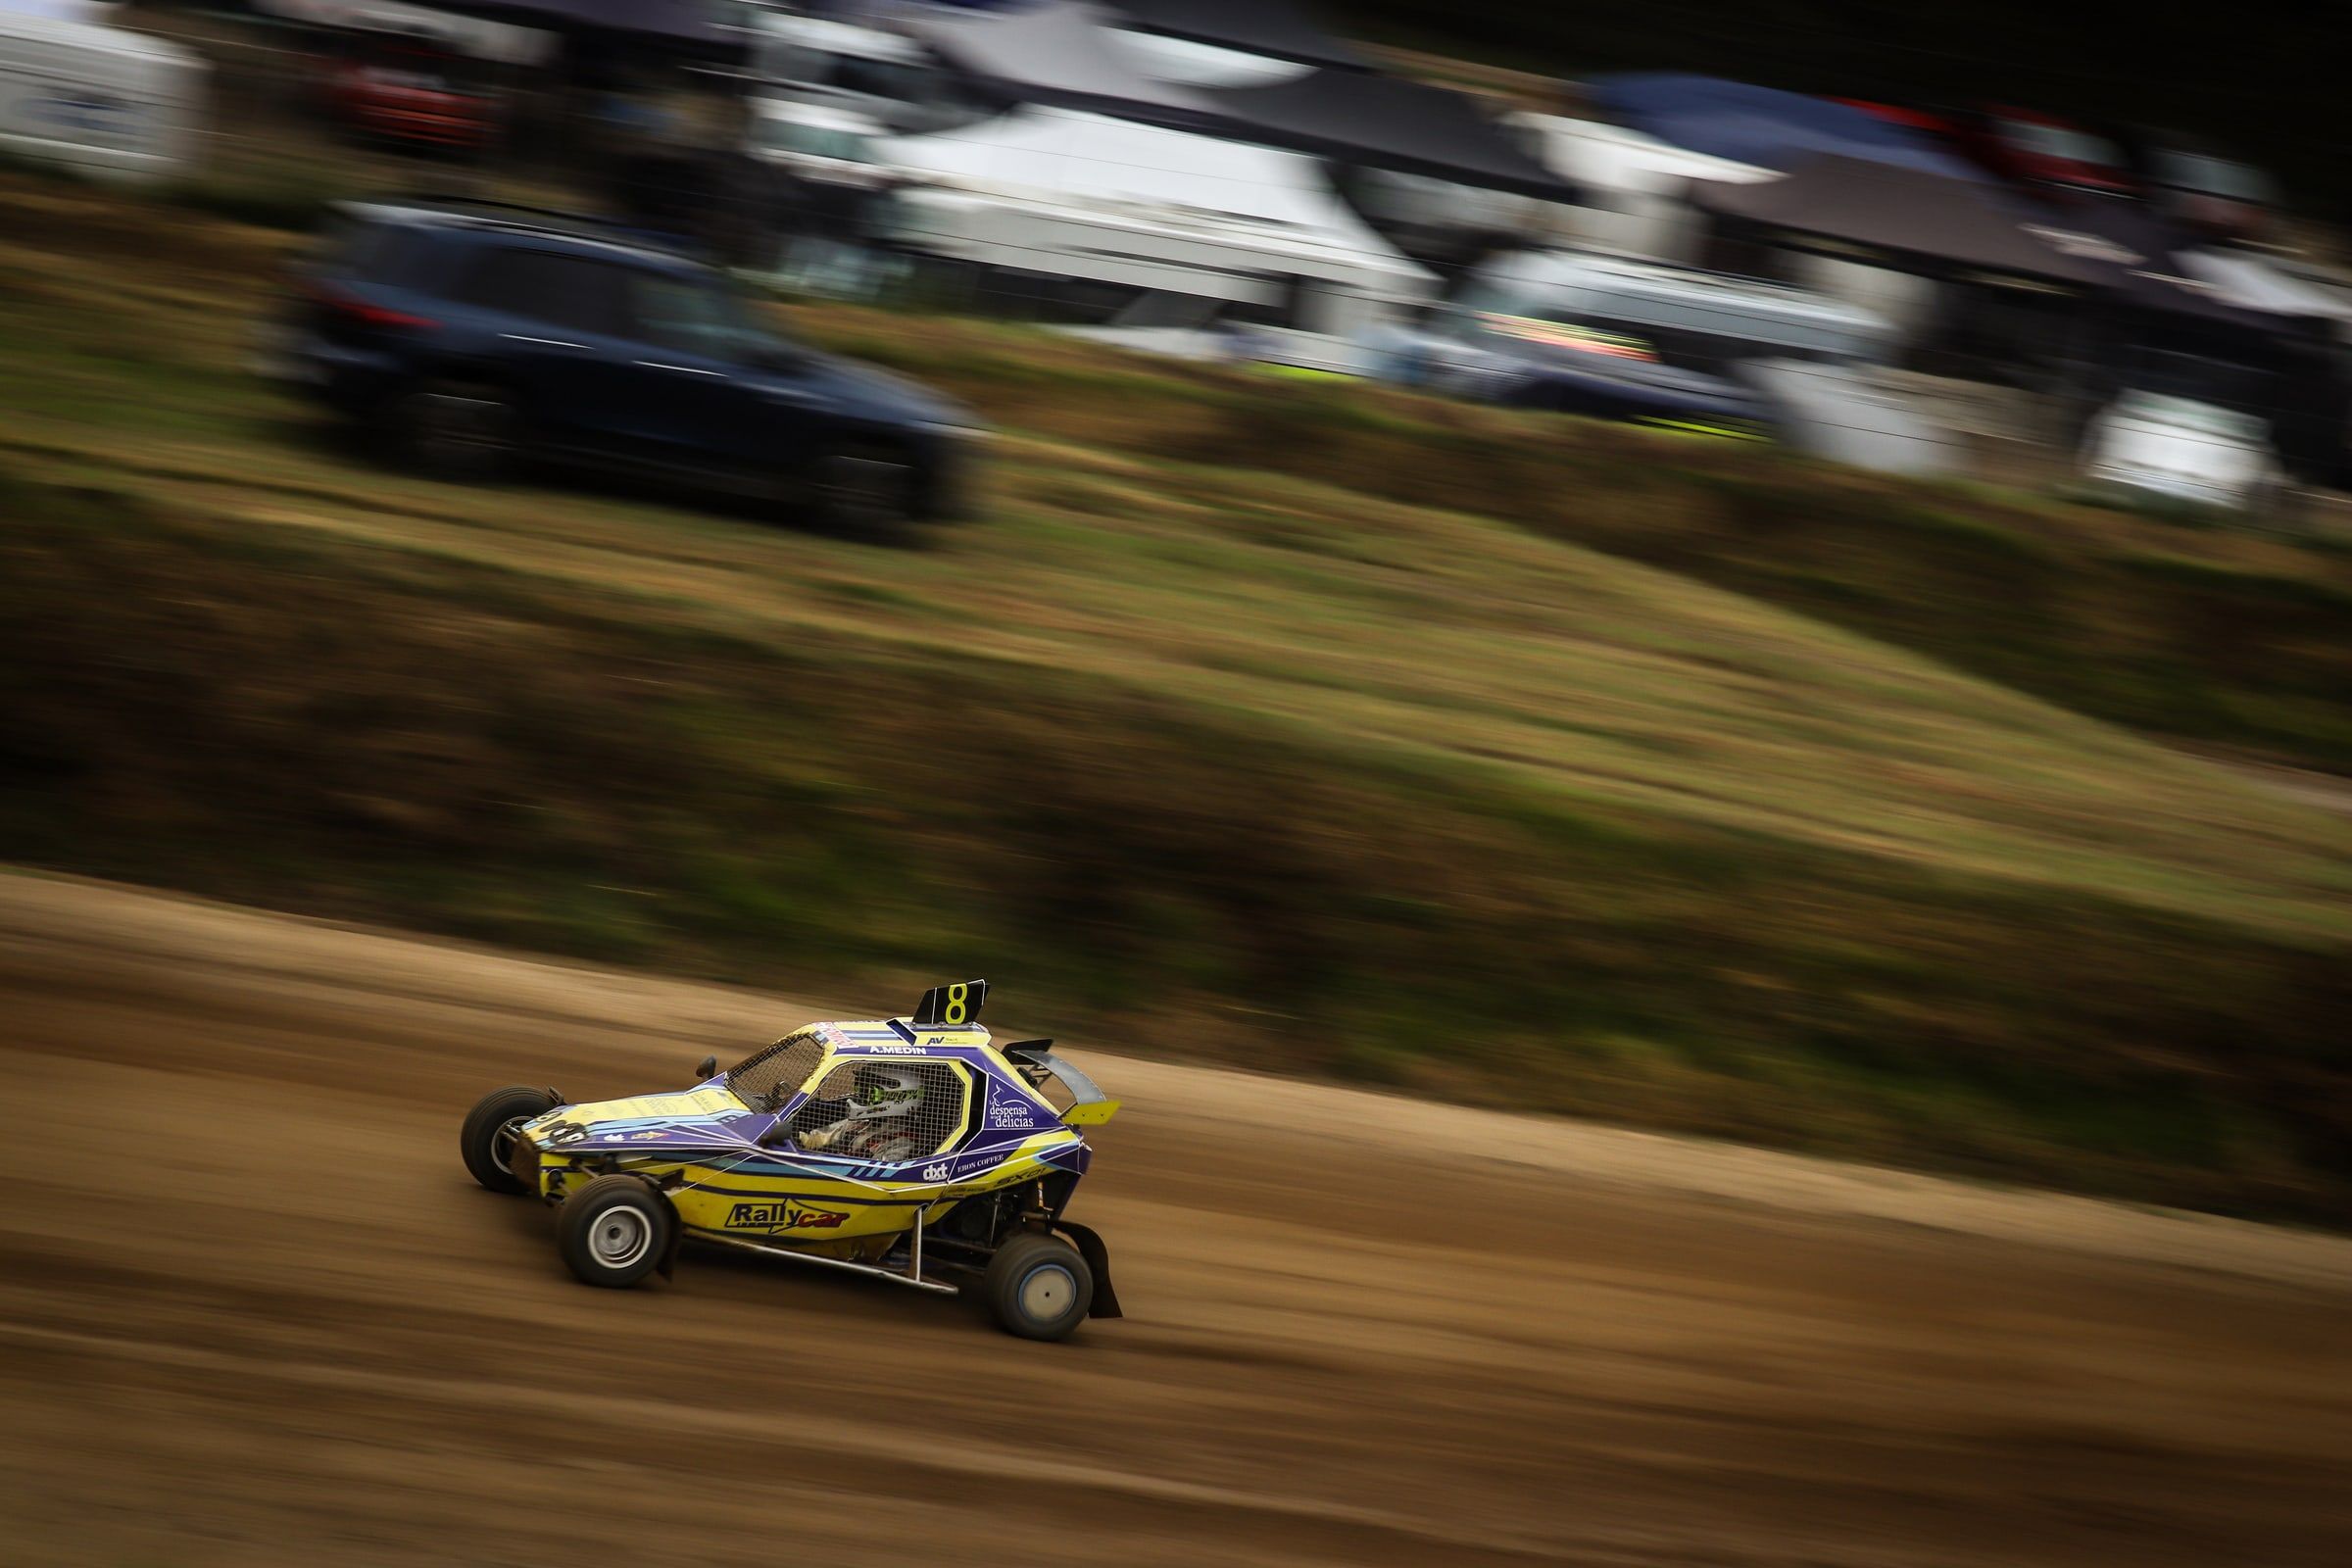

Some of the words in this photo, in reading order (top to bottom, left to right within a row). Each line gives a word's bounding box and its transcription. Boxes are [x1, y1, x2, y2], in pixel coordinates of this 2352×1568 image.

[946, 983, 967, 1024] 8
[990, 1105, 1027, 1117] despensa
[996, 1115, 1034, 1128] delicias
[977, 1154, 1004, 1166] COFFEE
